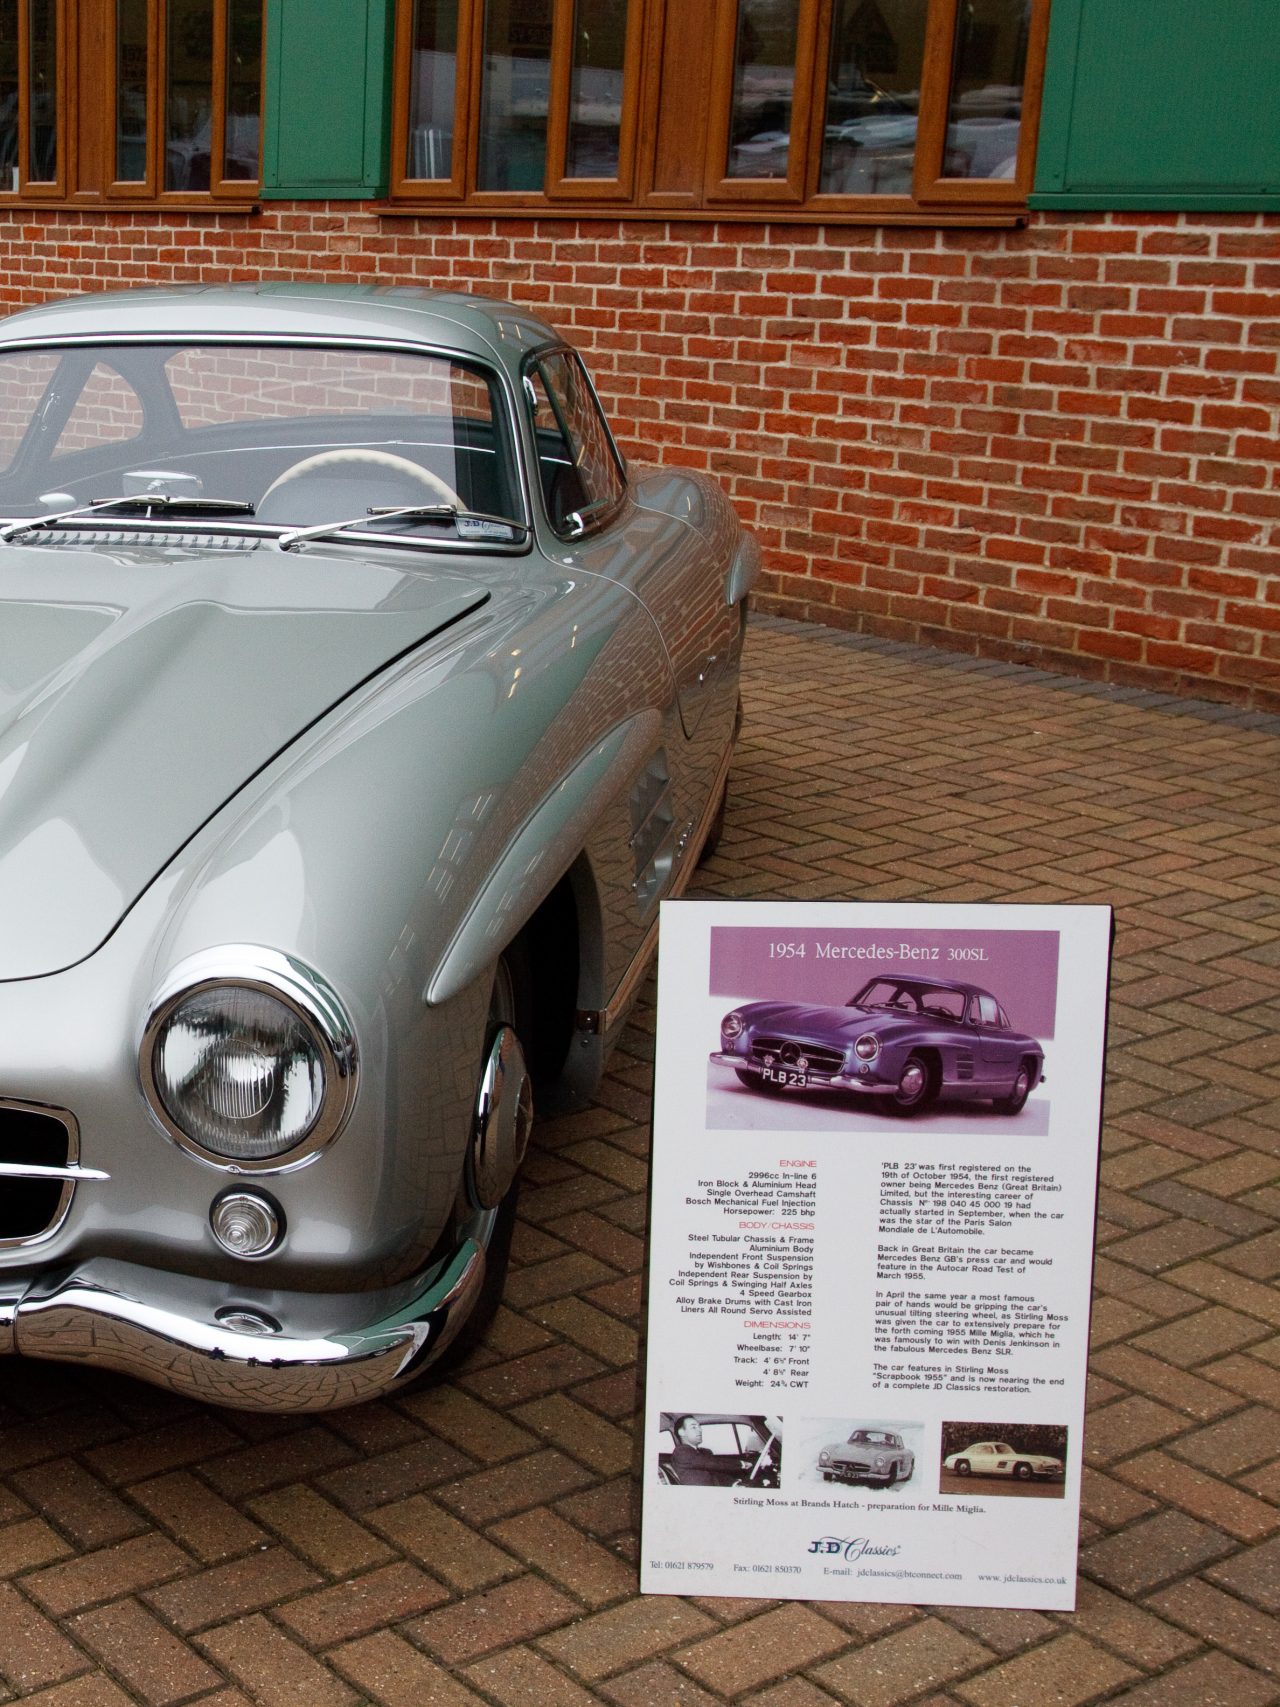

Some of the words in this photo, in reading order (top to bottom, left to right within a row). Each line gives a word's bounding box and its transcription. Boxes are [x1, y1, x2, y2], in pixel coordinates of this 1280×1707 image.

[769, 943, 806, 958] 1954
[815, 942, 940, 960] Mercedes-Benz
[947, 948, 989, 961] 300SL
[762, 1067, 787, 1084] PLB
[789, 1073, 807, 1087] 23
[779, 1159, 816, 1167] ENGINE
[959, 1164, 1000, 1172] registered
[1011, 1174, 1053, 1183] registered
[909, 1181, 931, 1189] being
[934, 1181, 974, 1189] Mercedes
[1031, 1183, 1061, 1191] Britain)
[707, 1188, 731, 1197] Single
[948, 1191, 991, 1199] interesting
[723, 1207, 774, 1215] Horsepower:
[771, 1222, 814, 1230] CHASSIS
[878, 1225, 914, 1233] Mondiale
[688, 1233, 708, 1241] Steel
[793, 1245, 813, 1253] Body
[689, 1252, 738, 1260] Independent
[767, 1253, 813, 1262] Suspension
[694, 1261, 704, 1269] by
[782, 1263, 813, 1271] Springs
[678, 1270, 727, 1278] Independent
[753, 1271, 799, 1279] Suspension
[688, 1278, 718, 1287] Springs
[731, 1280, 767, 1288] Swinging
[748, 1289, 774, 1297] Speed
[725, 1297, 750, 1305] Drums
[910, 1310, 931, 1318] tilting
[935, 1310, 968, 1318] steering
[1015, 1312, 1043, 1321] Stirling
[743, 1321, 810, 1329] DIMENSIONS
[753, 1333, 781, 1341] Length:
[735, 1379, 763, 1387] Weight:
[892, 1382, 929, 1390] complete
[945, 1383, 980, 1391] Classics
[733, 1497, 764, 1507] Stirling
[801, 1499, 830, 1507] Brands
[833, 1500, 859, 1508] Hatch
[867, 1503, 915, 1512] preparation
[956, 1505, 986, 1514] Miglia.
[843, 1537, 898, 1562] Classics
[824, 1567, 852, 1575] E-mail:
[856, 1568, 962, 1580] jdclassics@btconnect.com
